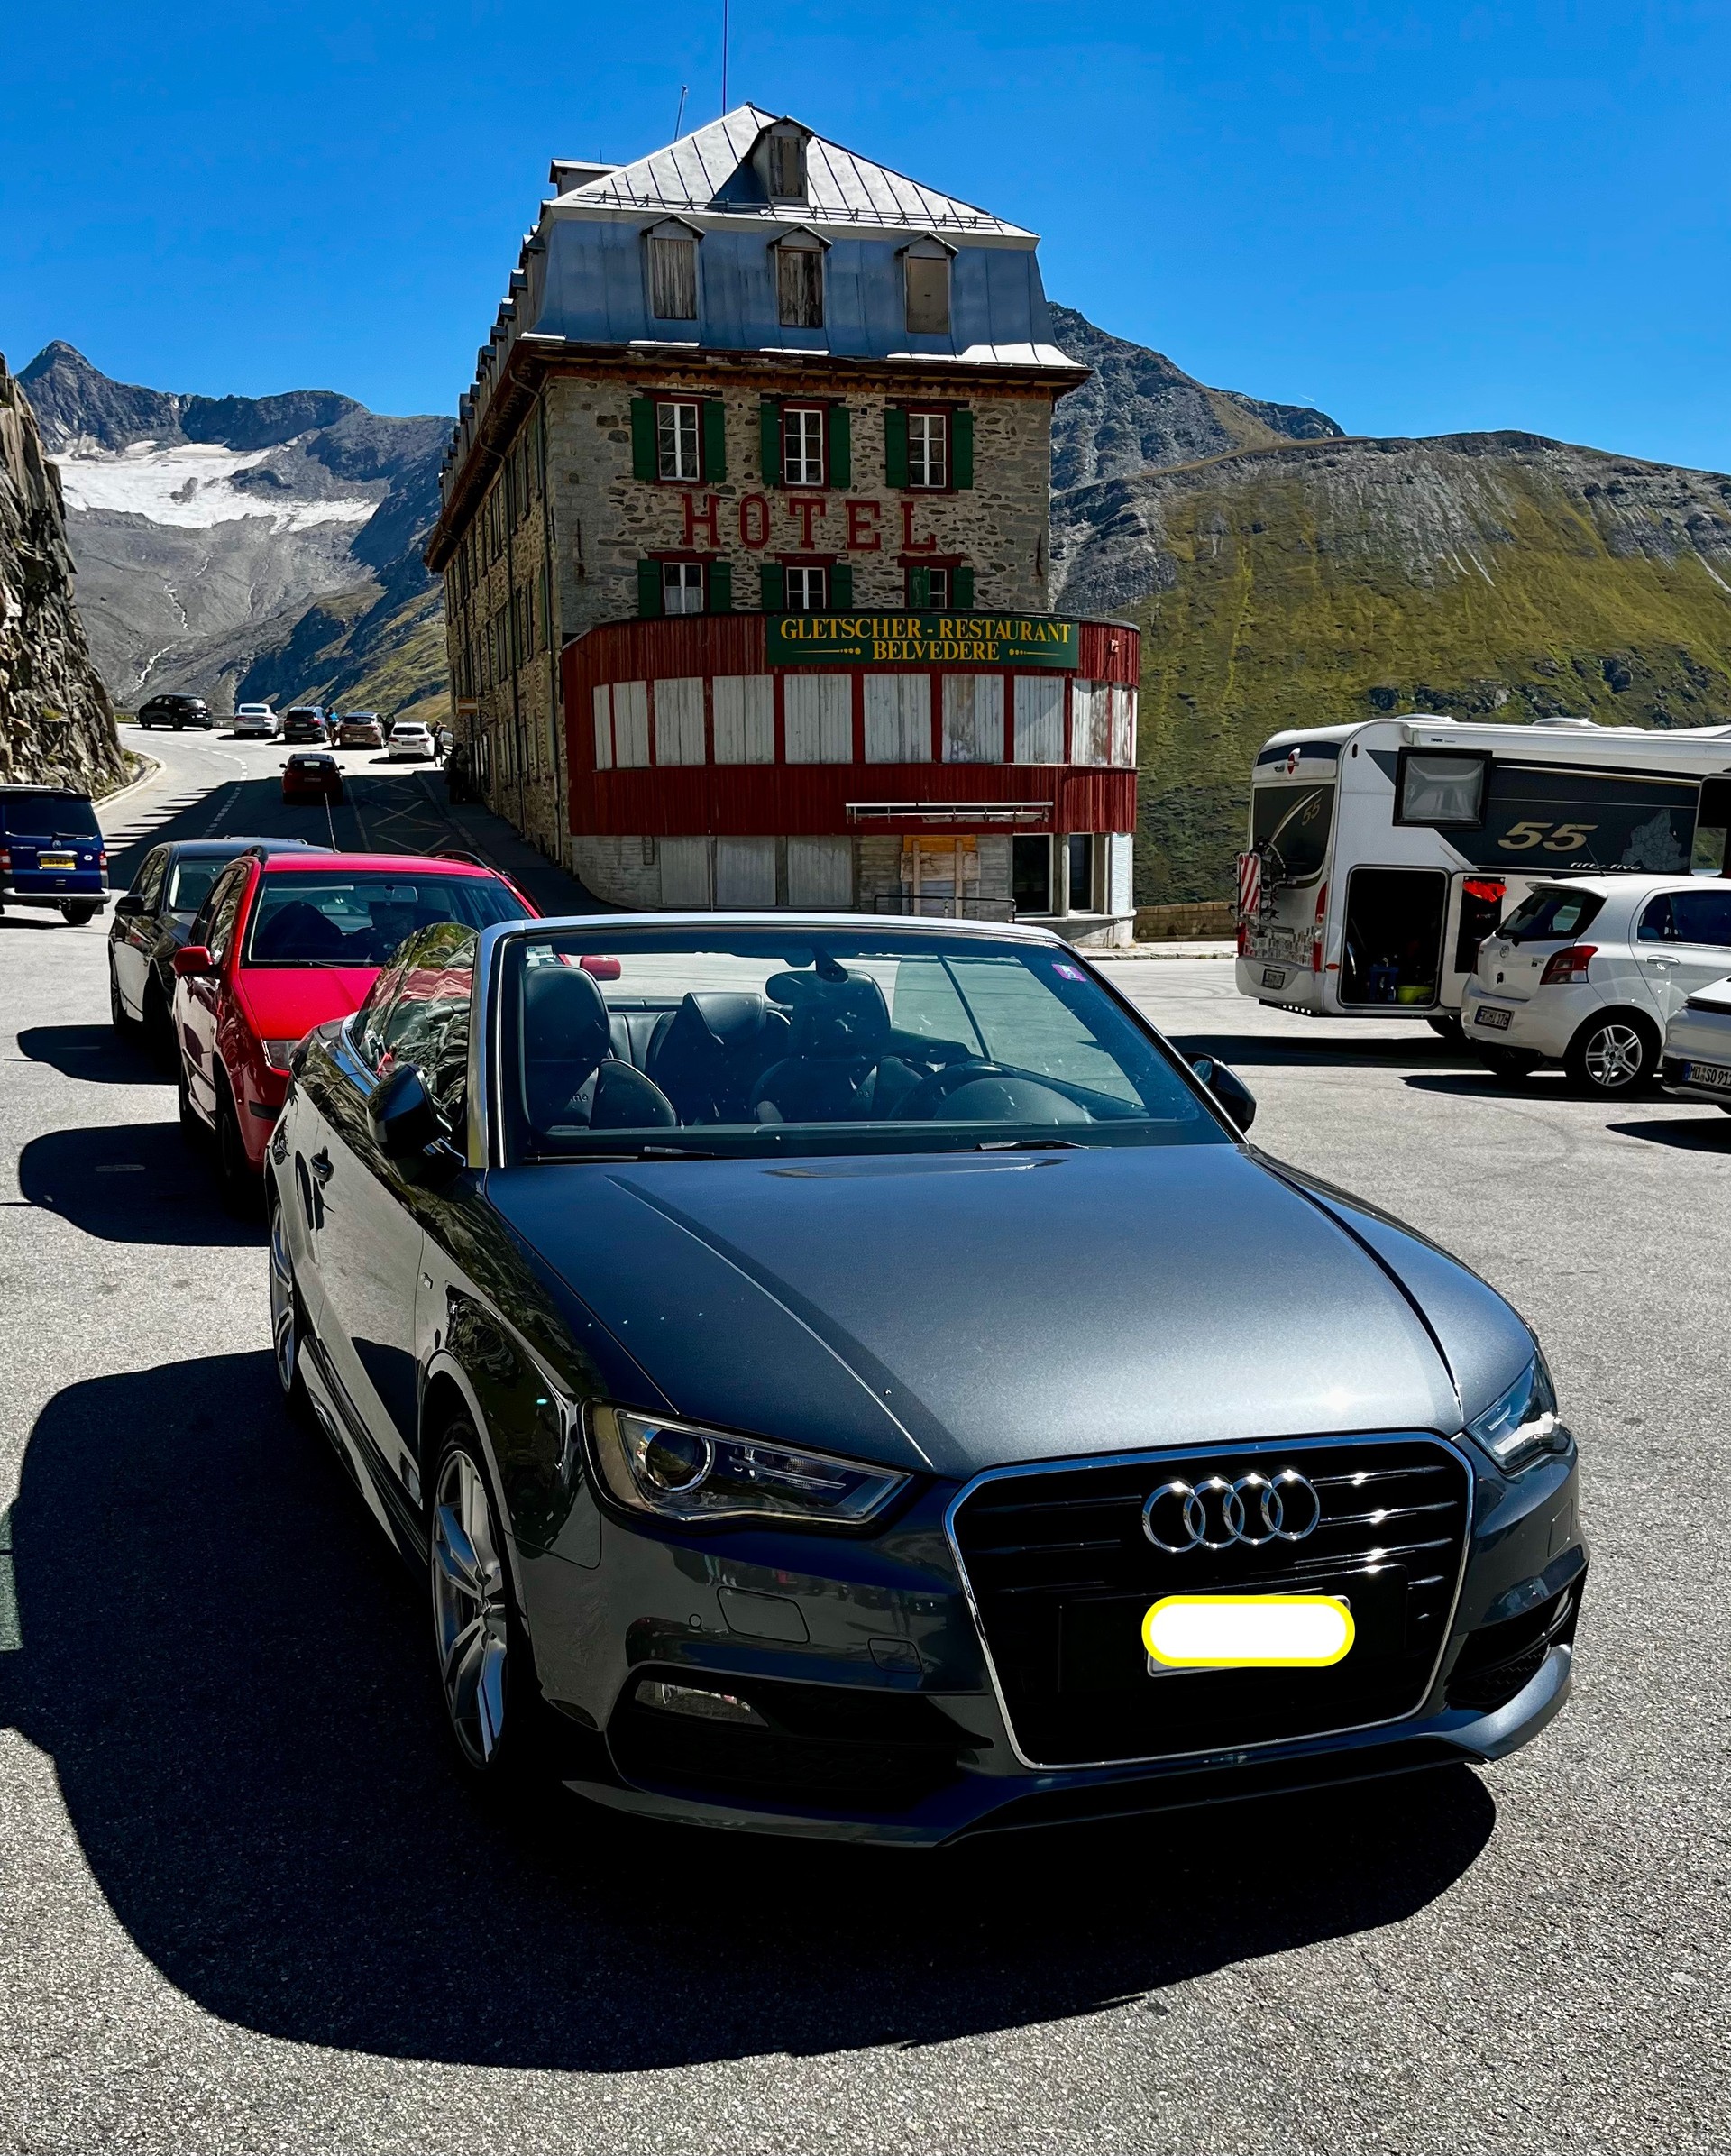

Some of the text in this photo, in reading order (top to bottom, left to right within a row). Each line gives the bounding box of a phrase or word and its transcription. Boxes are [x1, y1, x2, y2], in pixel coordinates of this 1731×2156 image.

[681, 493, 936, 552] HOTEL
[780, 618, 921, 639] GLETSCHER
[938, 619, 1071, 644] RESTAURANT
[872, 640, 1000, 661] BELVEDERE
[1301, 796, 1323, 826] 55
[1497, 821, 1599, 851] 55
